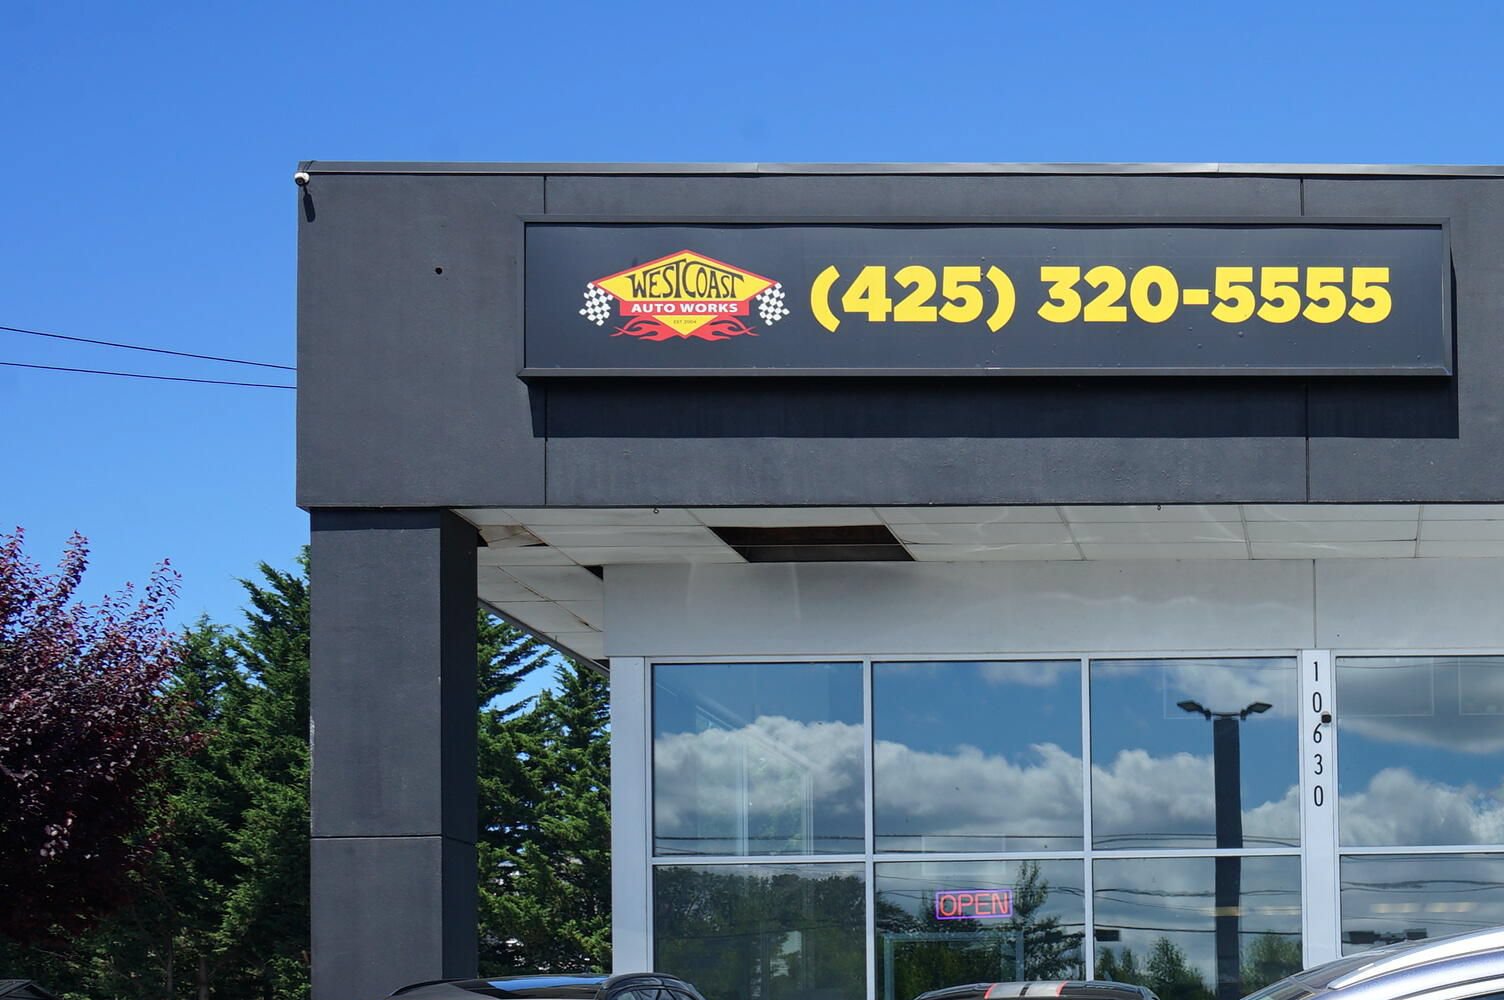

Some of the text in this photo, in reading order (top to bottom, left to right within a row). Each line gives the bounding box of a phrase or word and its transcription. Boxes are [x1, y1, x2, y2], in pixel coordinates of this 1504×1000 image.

[624, 258, 745, 299] WESTCOAST
[811, 266, 1391, 332] (425) 320-5555
[631, 303, 738, 313] AUTO WORKS
[1312, 661, 1324, 806] 10630
[940, 892, 1009, 916] OPEN
